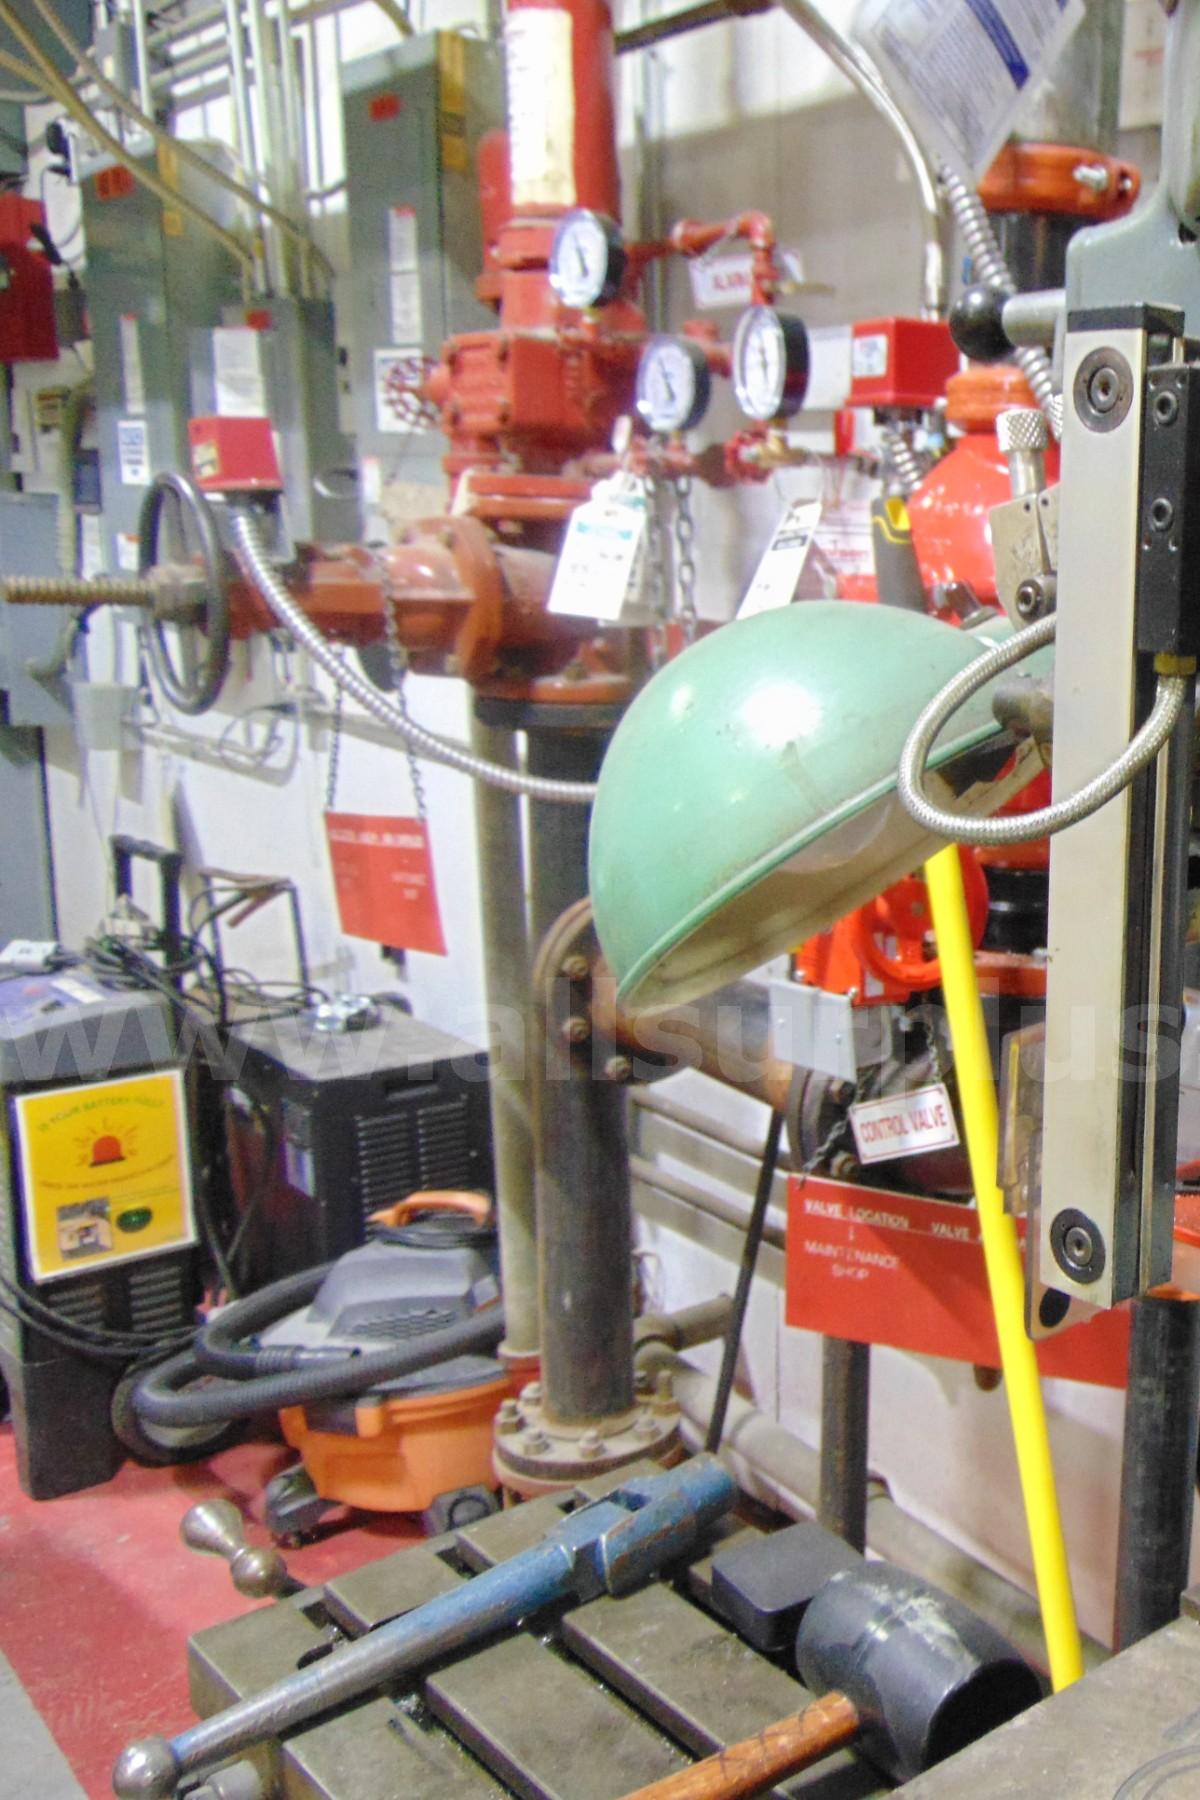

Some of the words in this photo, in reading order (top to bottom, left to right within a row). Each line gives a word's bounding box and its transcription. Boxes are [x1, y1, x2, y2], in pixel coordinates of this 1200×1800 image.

[860, 1113, 909, 1143] CONTROL
[909, 1103, 948, 1132] VALVE
[803, 1198, 843, 1218] VALVE
[849, 1204, 910, 1229] LOCATION
[931, 1221, 971, 1242] VALVE
